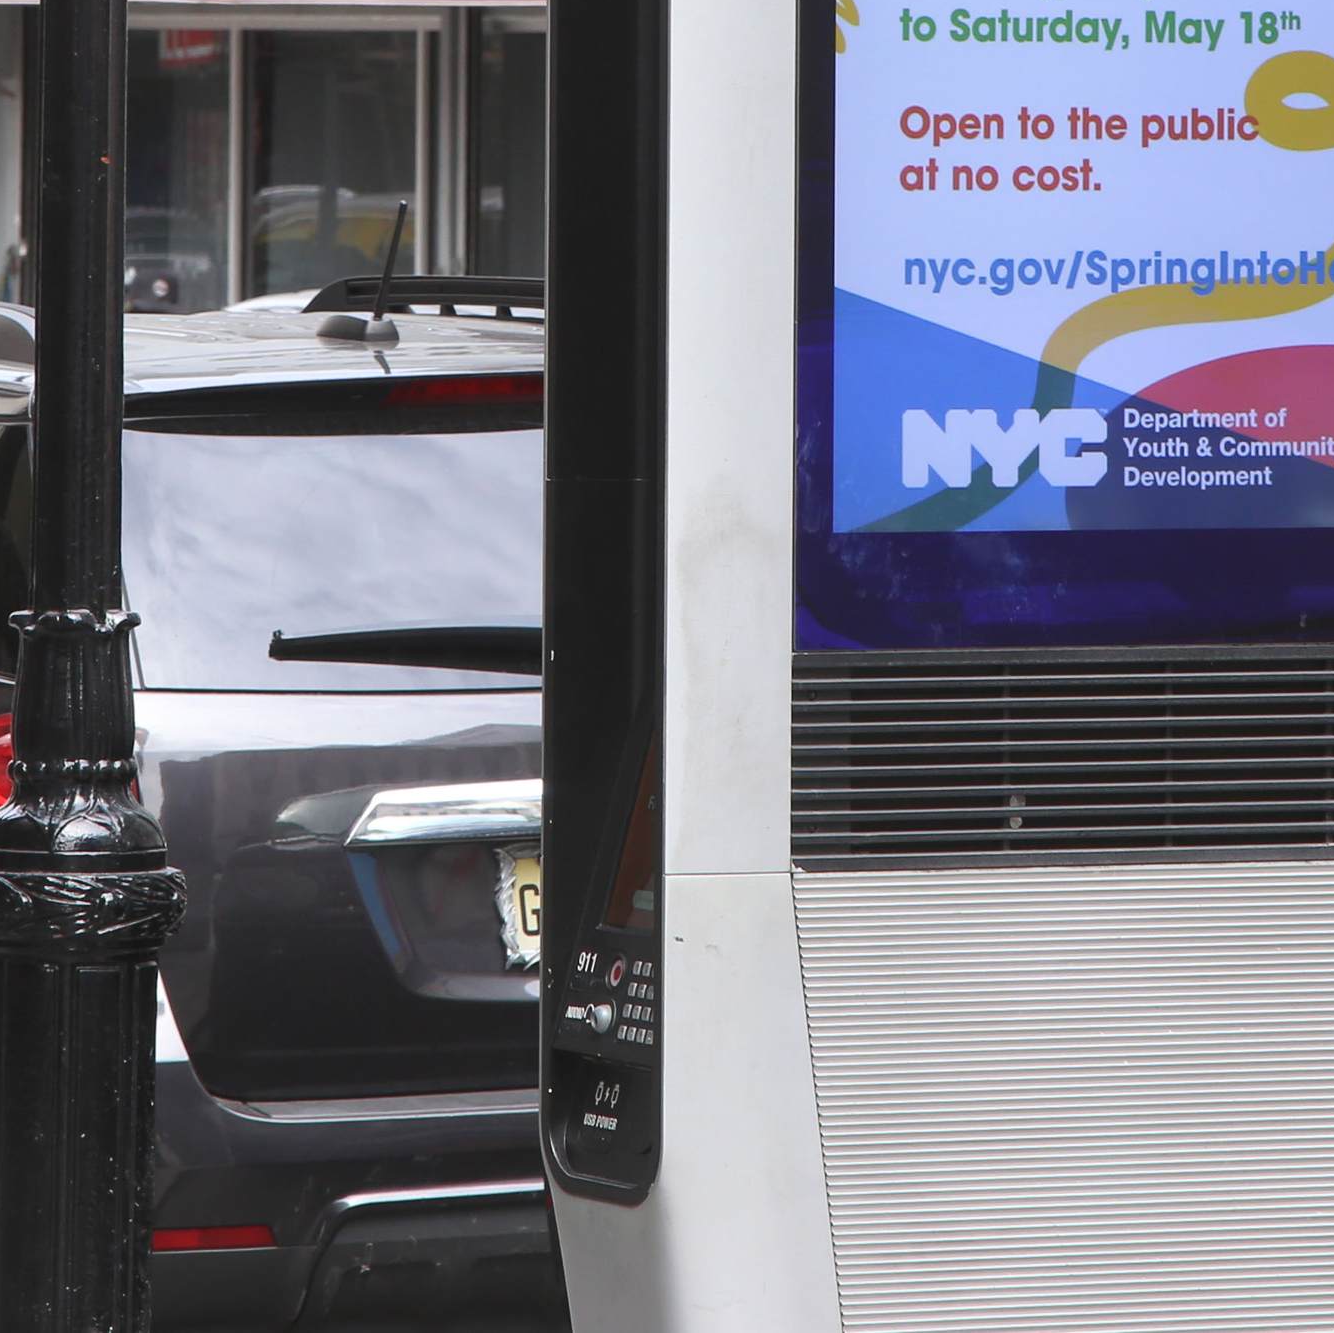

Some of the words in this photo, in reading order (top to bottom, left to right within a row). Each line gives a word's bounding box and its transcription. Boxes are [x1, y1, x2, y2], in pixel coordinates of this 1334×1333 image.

[900, 9, 936, 41] to
[950, 9, 1129, 49] Saturday,
[1144, 11, 1224, 51] May
[1239, 10, 1301, 43] 18th
[900, 105, 1004, 147] Open
[1018, 107, 1054, 140] to
[1067, 107, 1128, 140] the
[1142, 107, 1259, 148] public
[900, 158, 938, 191] at
[952, 162, 998, 191] no
[1012, 158, 1102, 192] cost.
[1124, 408, 1256, 434] Department
[1263, 407, 1287, 428] of
[902, 408, 1108, 488] NYC
[1123, 436, 1189, 458] Youth
[1196, 437, 1212, 457] &
[1123, 466, 1273, 490] Development
[577, 952, 598, 973] 911
